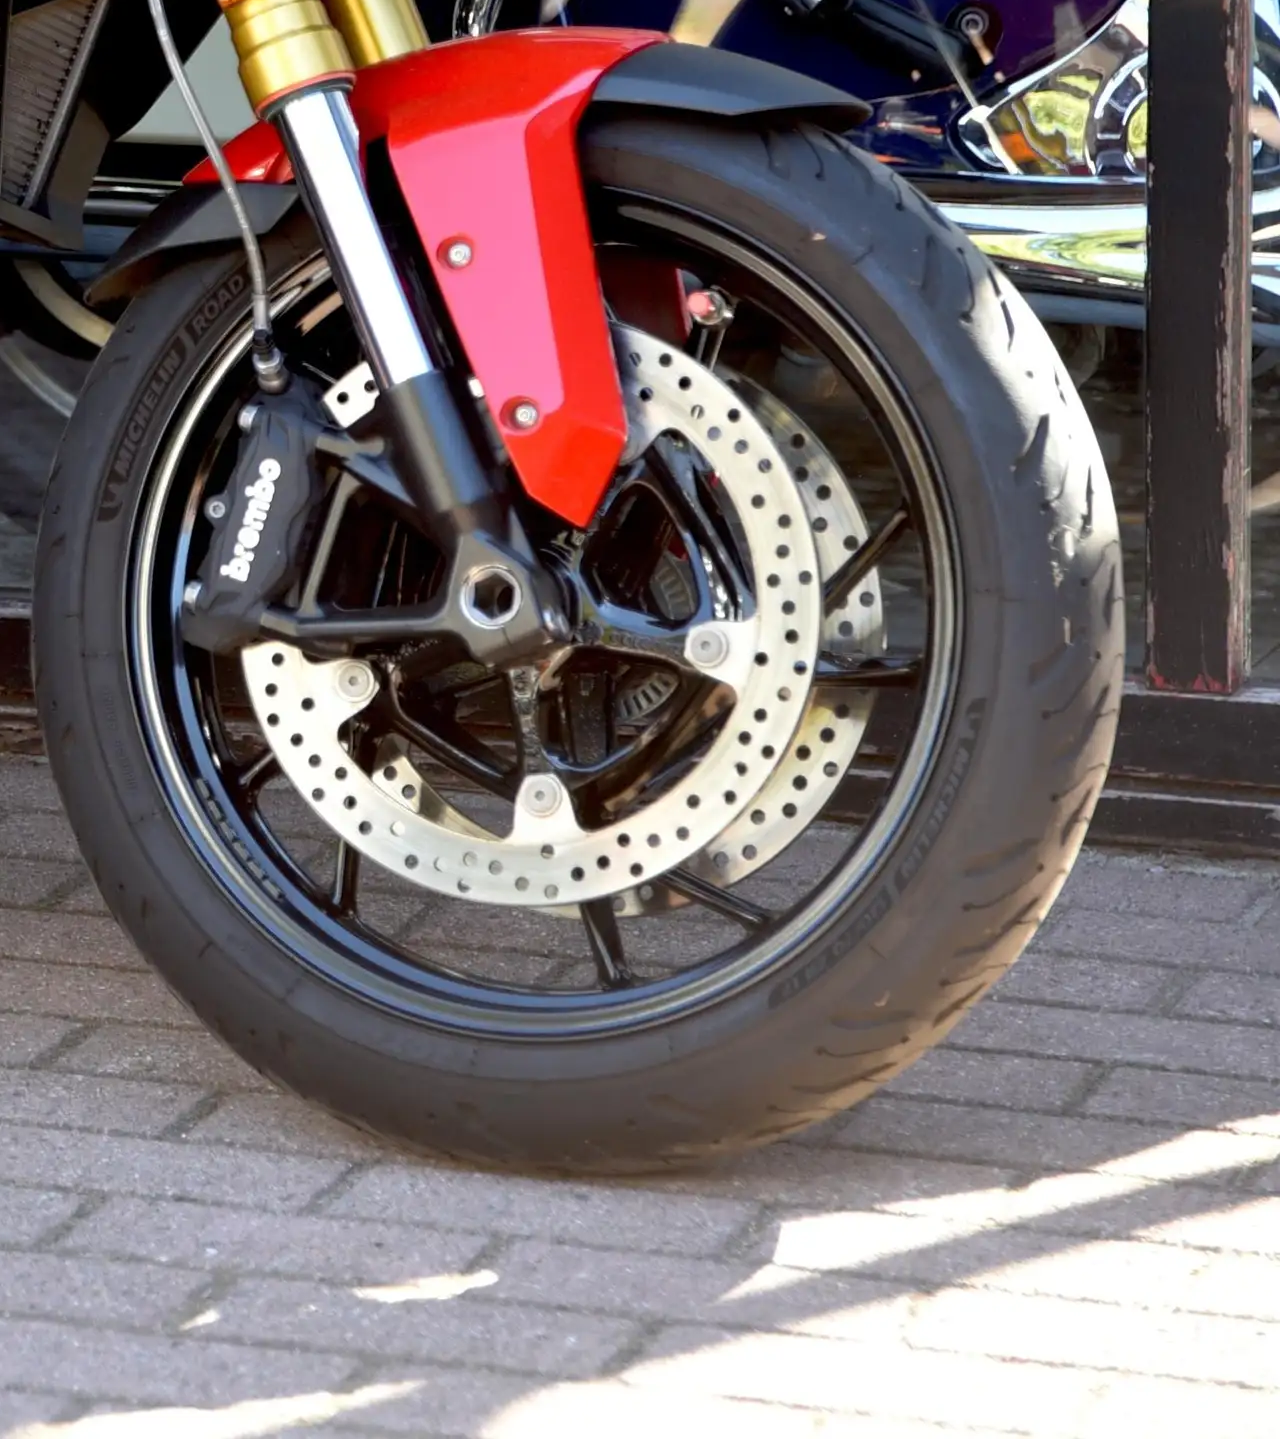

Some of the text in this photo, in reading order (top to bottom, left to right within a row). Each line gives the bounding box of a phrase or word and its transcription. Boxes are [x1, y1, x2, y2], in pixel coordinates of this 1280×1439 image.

[114, 274, 245, 478] MICHELIN ROAD
[220, 458, 281, 582] brembo
